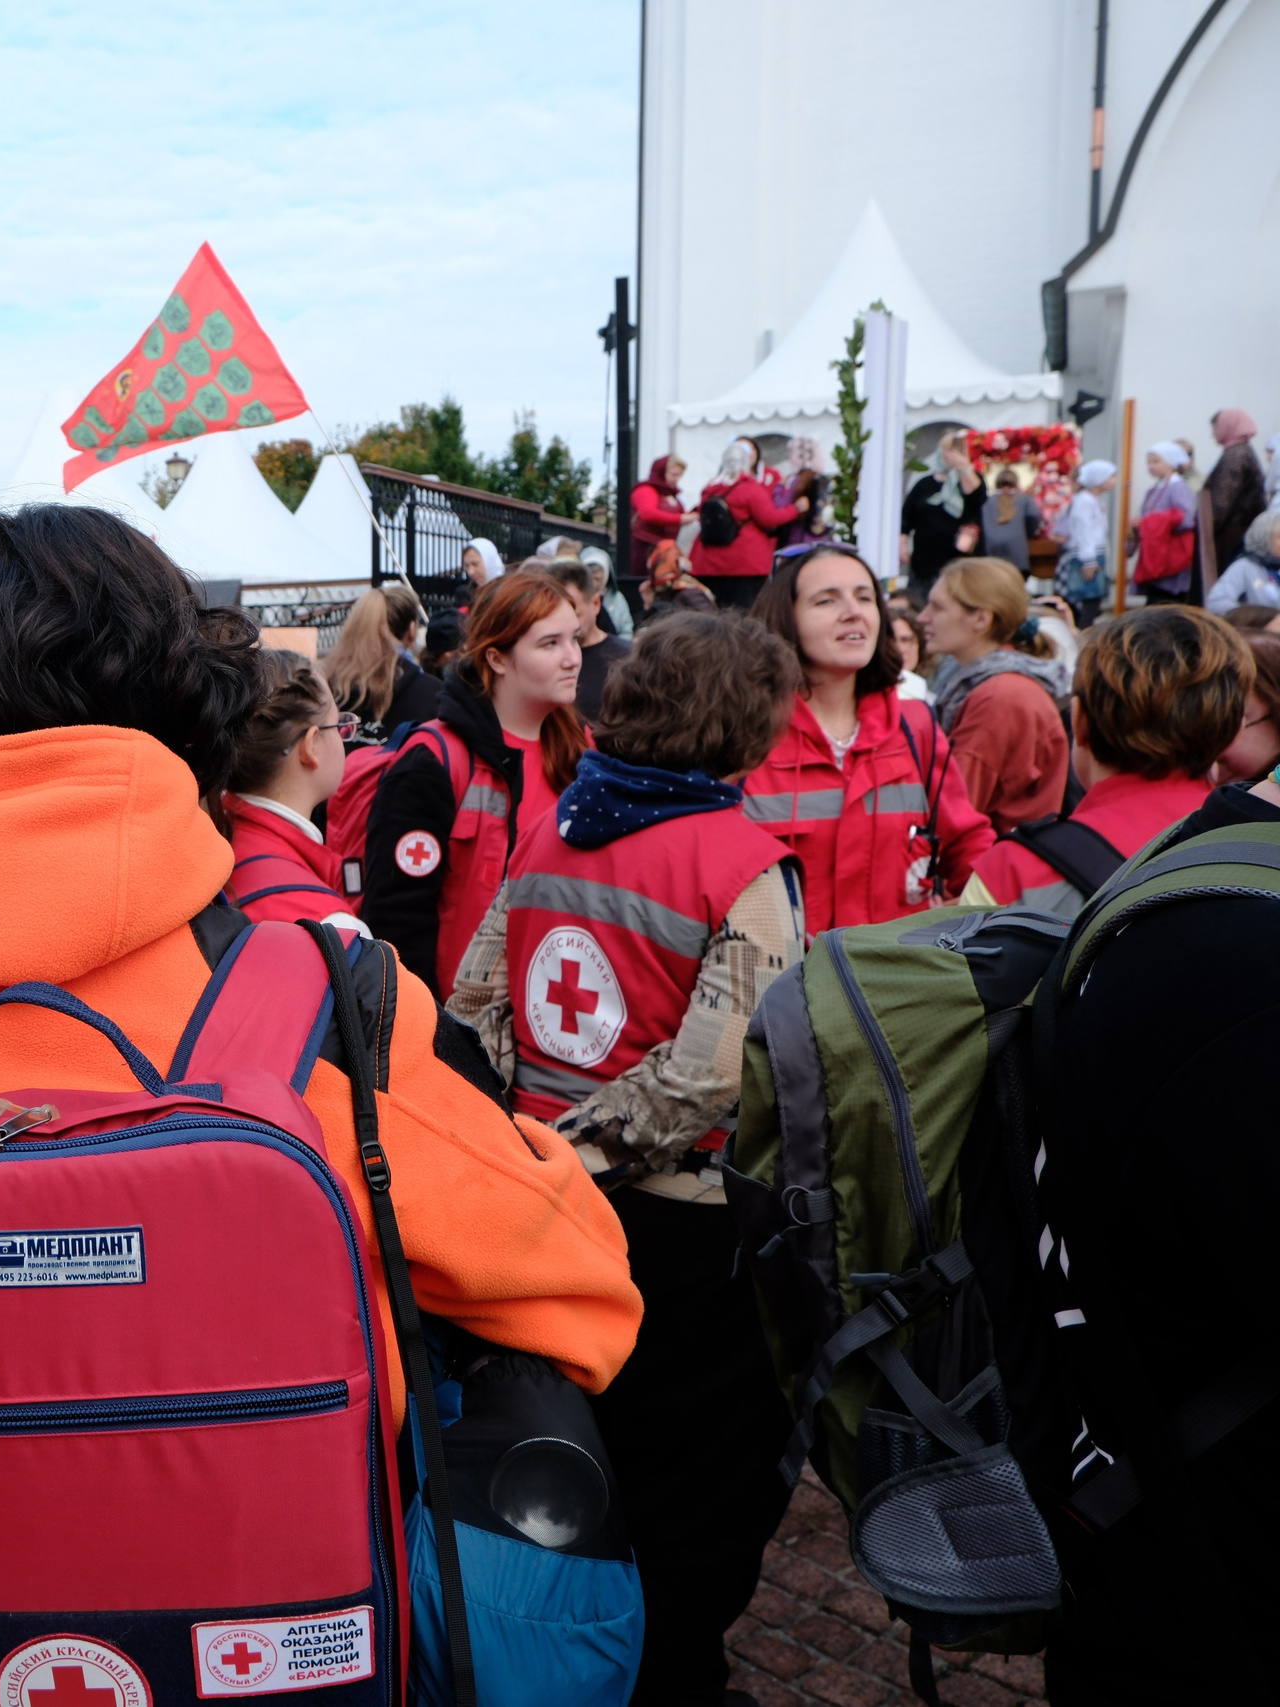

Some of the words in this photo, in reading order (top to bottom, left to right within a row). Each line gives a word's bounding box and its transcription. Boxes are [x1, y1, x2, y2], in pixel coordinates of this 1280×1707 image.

[539, 937, 612, 984] РОССИЙСКИЙ
[532, 1003, 575, 1059] КРАСНЫЙ
[581, 1020, 612, 1058] КРЕСТ
[26, 1235, 135, 1261] МЕДПЛАНТ
[27, 1260, 90, 1269] производственное
[92, 1258, 136, 1268] предприятие
[17, 1272, 59, 1281] 223-6016
[65, 1270, 138, 1281] www.medplant.ru
[280, 1628, 364, 1648] ОКАЗАНИЯ
[286, 1619, 357, 1637] АПТЕЧКА
[212, 1631, 270, 1650] РОССИЙСКИЙ
[292, 1641, 354, 1659] ПЕРВОЙ
[56, 1646, 130, 1681] КРАСНЫЙ
[288, 1651, 360, 1671] ПОМОЩИ
[211, 1665, 251, 1686] КРАСНЫЙ
[253, 1661, 273, 1683] КРЕСТ
[288, 1664, 361, 1682] «БАРС-М»
